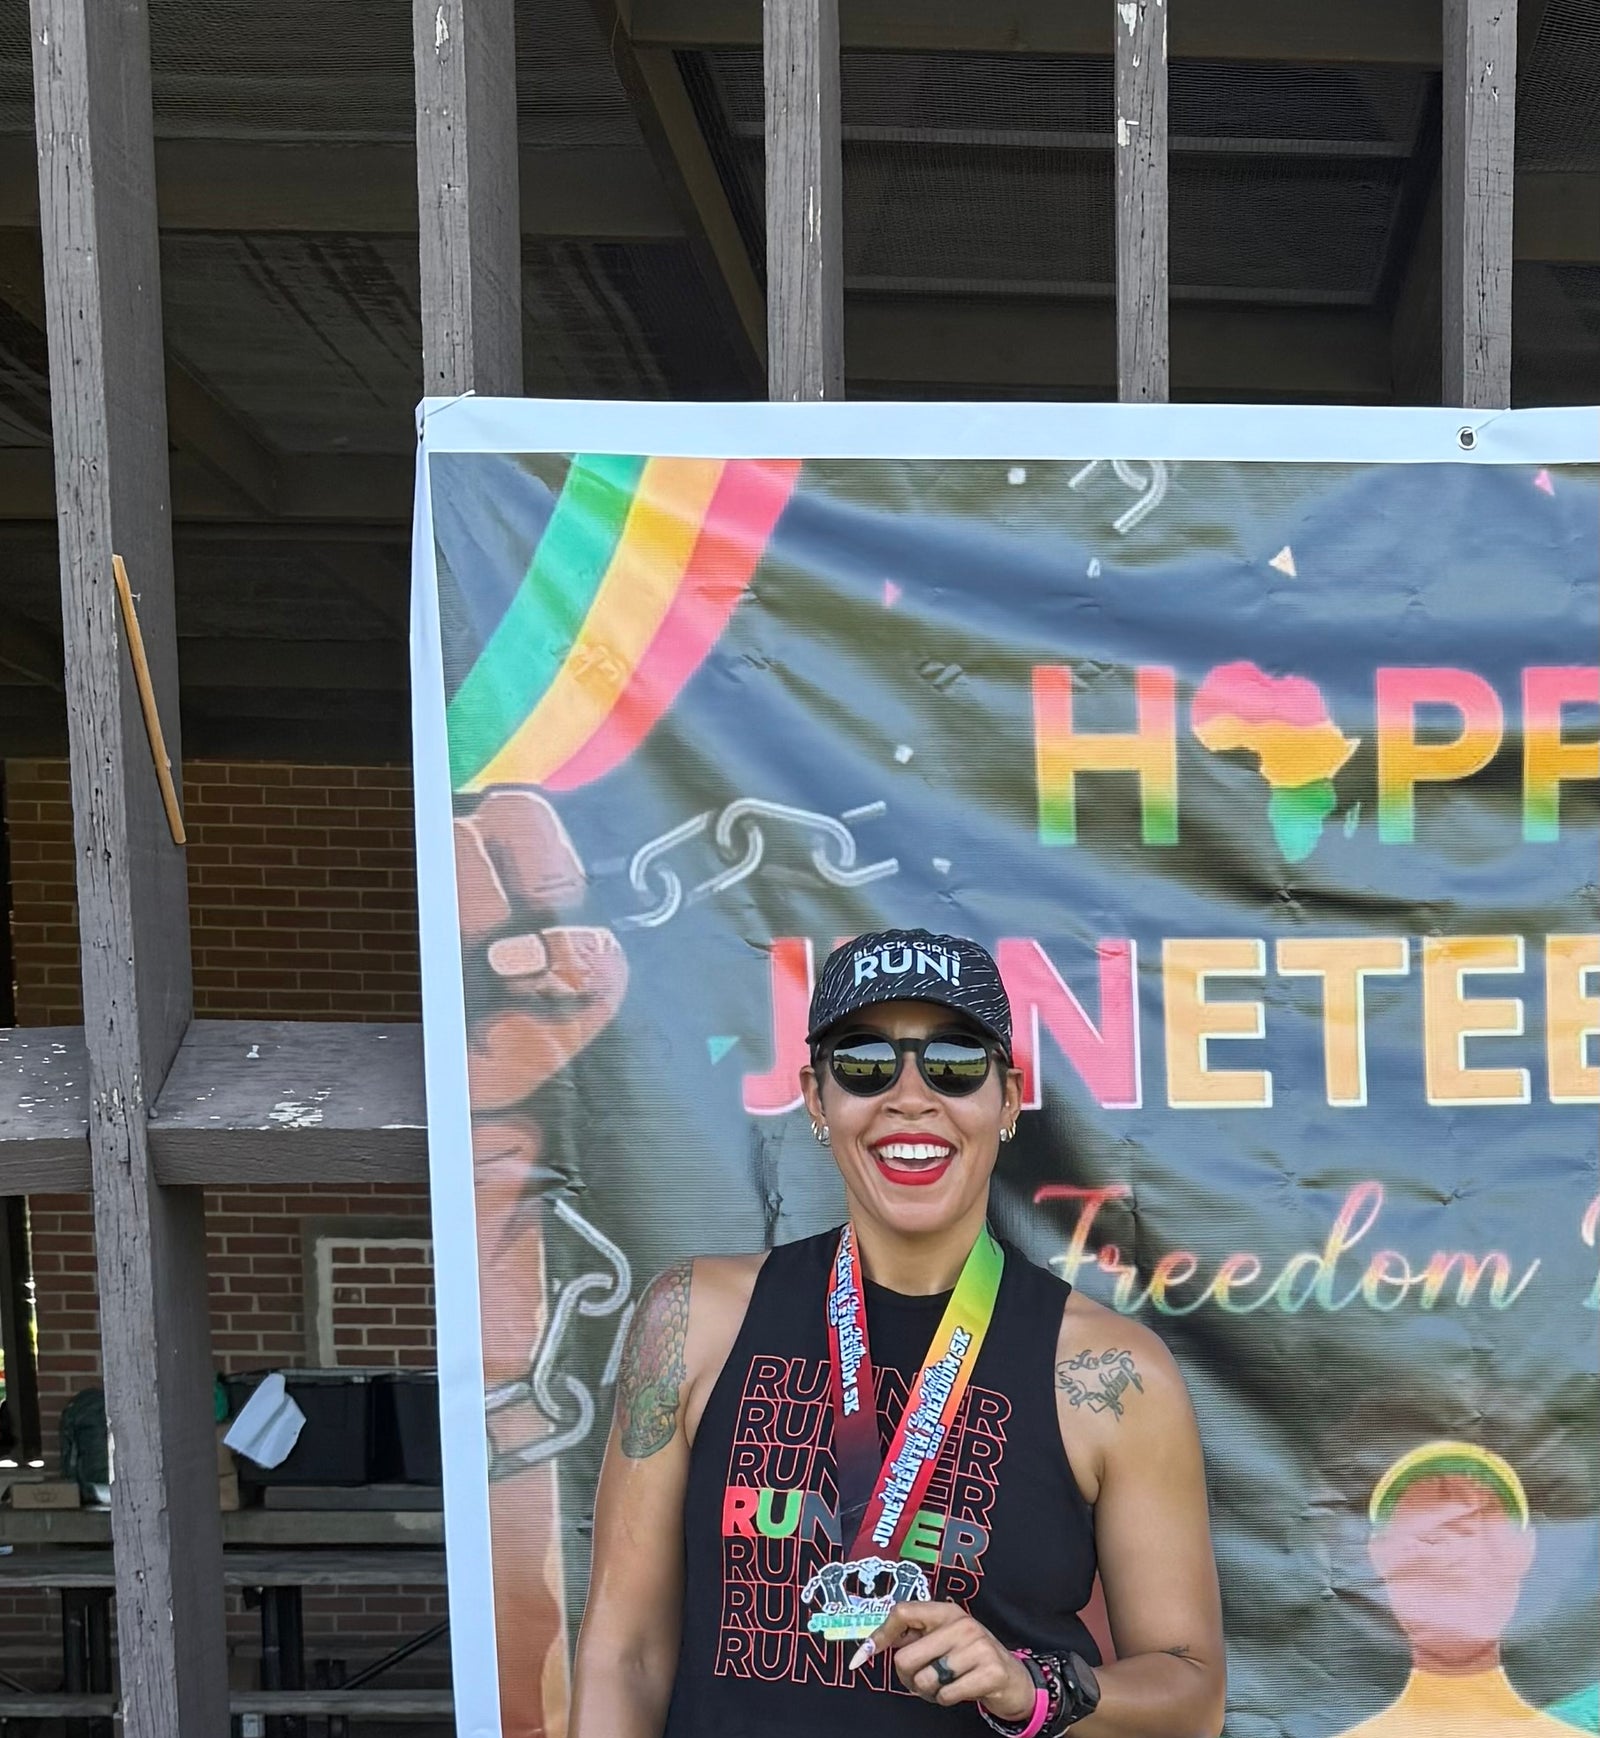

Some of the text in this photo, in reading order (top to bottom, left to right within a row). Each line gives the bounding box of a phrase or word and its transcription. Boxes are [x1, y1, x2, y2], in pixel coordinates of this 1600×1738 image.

[854, 941, 961, 961] BLACK GIRLS
[854, 949, 961, 987] RUN!
[742, 935, 1600, 1115] JNETEE
[1034, 1181, 1540, 1316] Freedom
[843, 1387, 860, 1416] 5K
[872, 1326, 971, 1548] JUNETEENTH FREEDOM 5K
[722, 1486, 989, 1575] RUNER
